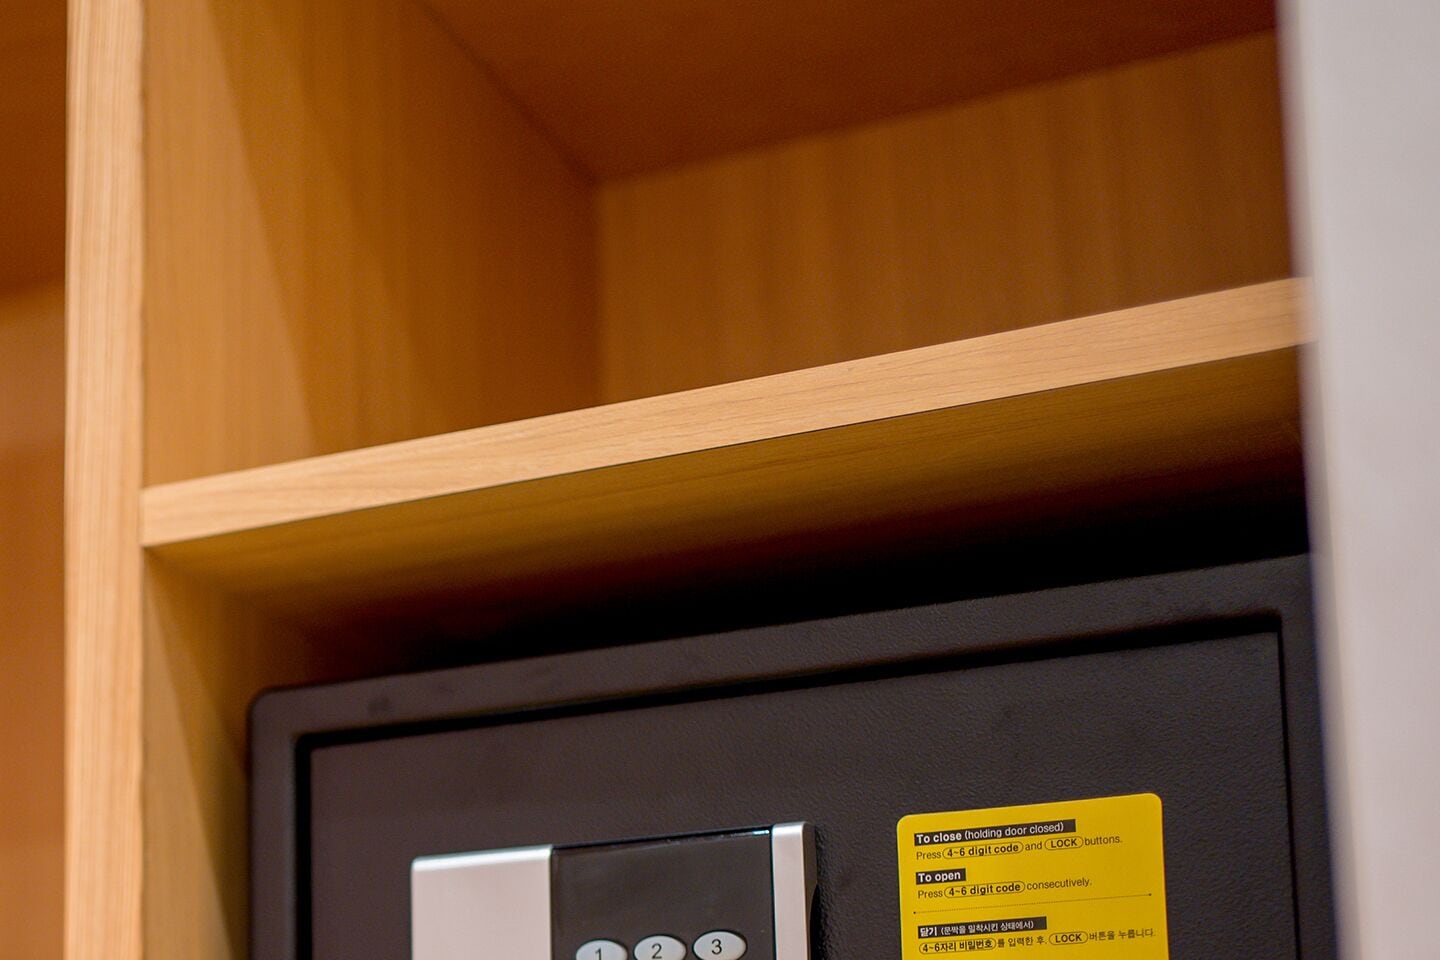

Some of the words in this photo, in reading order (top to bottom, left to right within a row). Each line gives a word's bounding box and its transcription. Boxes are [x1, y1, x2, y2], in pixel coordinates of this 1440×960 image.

[916, 833, 931, 845] To
[933, 830, 962, 843] close
[964, 827, 1002, 842] (holding
[1004, 825, 1027, 838] door
[1029, 822, 1064, 835] closed)
[916, 849, 941, 861] Press
[968, 844, 991, 857] digit
[993, 843, 1019, 854] code
[1025, 841, 1043, 851] and
[1050, 838, 1078, 849] LOCK
[1084, 834, 1123, 847] buttons.
[918, 872, 932, 884] To
[934, 870, 961, 884] open
[917, 888, 943, 900] Press
[970, 884, 993, 897] digit
[995, 882, 1021, 893] code
[1026, 877, 1092, 891] consecutively.
[711, 938, 723, 955] 3
[1007, 935, 1034, 948] 입력한
[1055, 932, 1083, 943] LOCK
[1089, 930, 1115, 942] 버튼을
[651, 943, 663, 960] 2
